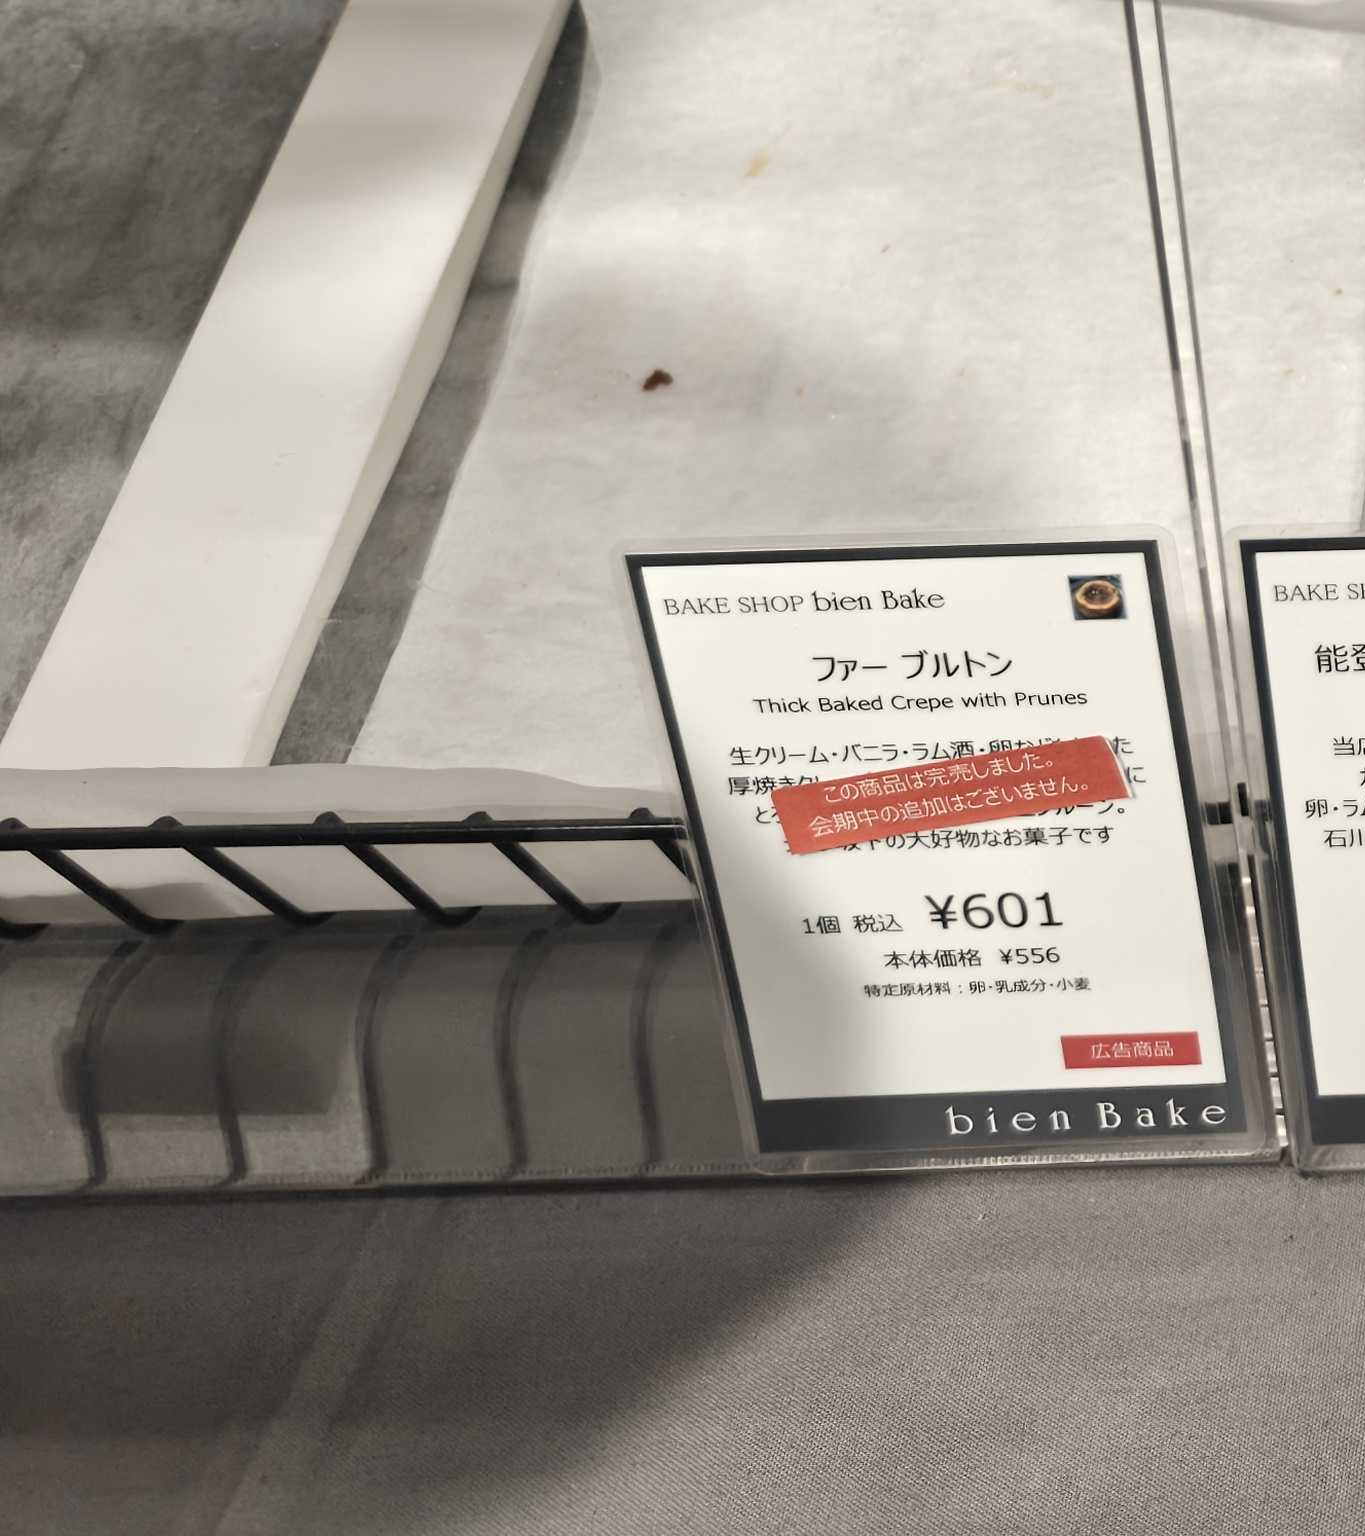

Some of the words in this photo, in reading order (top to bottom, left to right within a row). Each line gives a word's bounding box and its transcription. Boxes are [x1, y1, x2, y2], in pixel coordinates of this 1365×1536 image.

[663, 597, 731, 616] BAKE
[737, 595, 804, 614] SHOP
[811, 590, 873, 612] bien
[880, 588, 945, 610] Bake
[1274, 583, 1339, 602] BAKE
[812, 656, 888, 682] ファー
[901, 649, 1013, 680] ブルトン
[752, 697, 812, 714] Thick
[818, 695, 884, 713] Baked
[890, 695, 954, 713] Crepe
[960, 691, 1007, 708] with
[1014, 691, 1088, 707] Prunes
[824, 755, 1053, 802] この商品は完売しました。
[809, 777, 1088, 837] 会期中の追加はございません。
[802, 915, 841, 935] 1個
[852, 913, 904, 934] 税込
[924, 891, 1064, 930] ¥601
[884, 948, 982, 969] 本体価格
[999, 946, 1061, 965] ¥556
[1091, 1040, 1174, 1059] 広告商品
[945, 1105, 1071, 1135] bien
[1096, 1098, 1226, 1129] Bake
